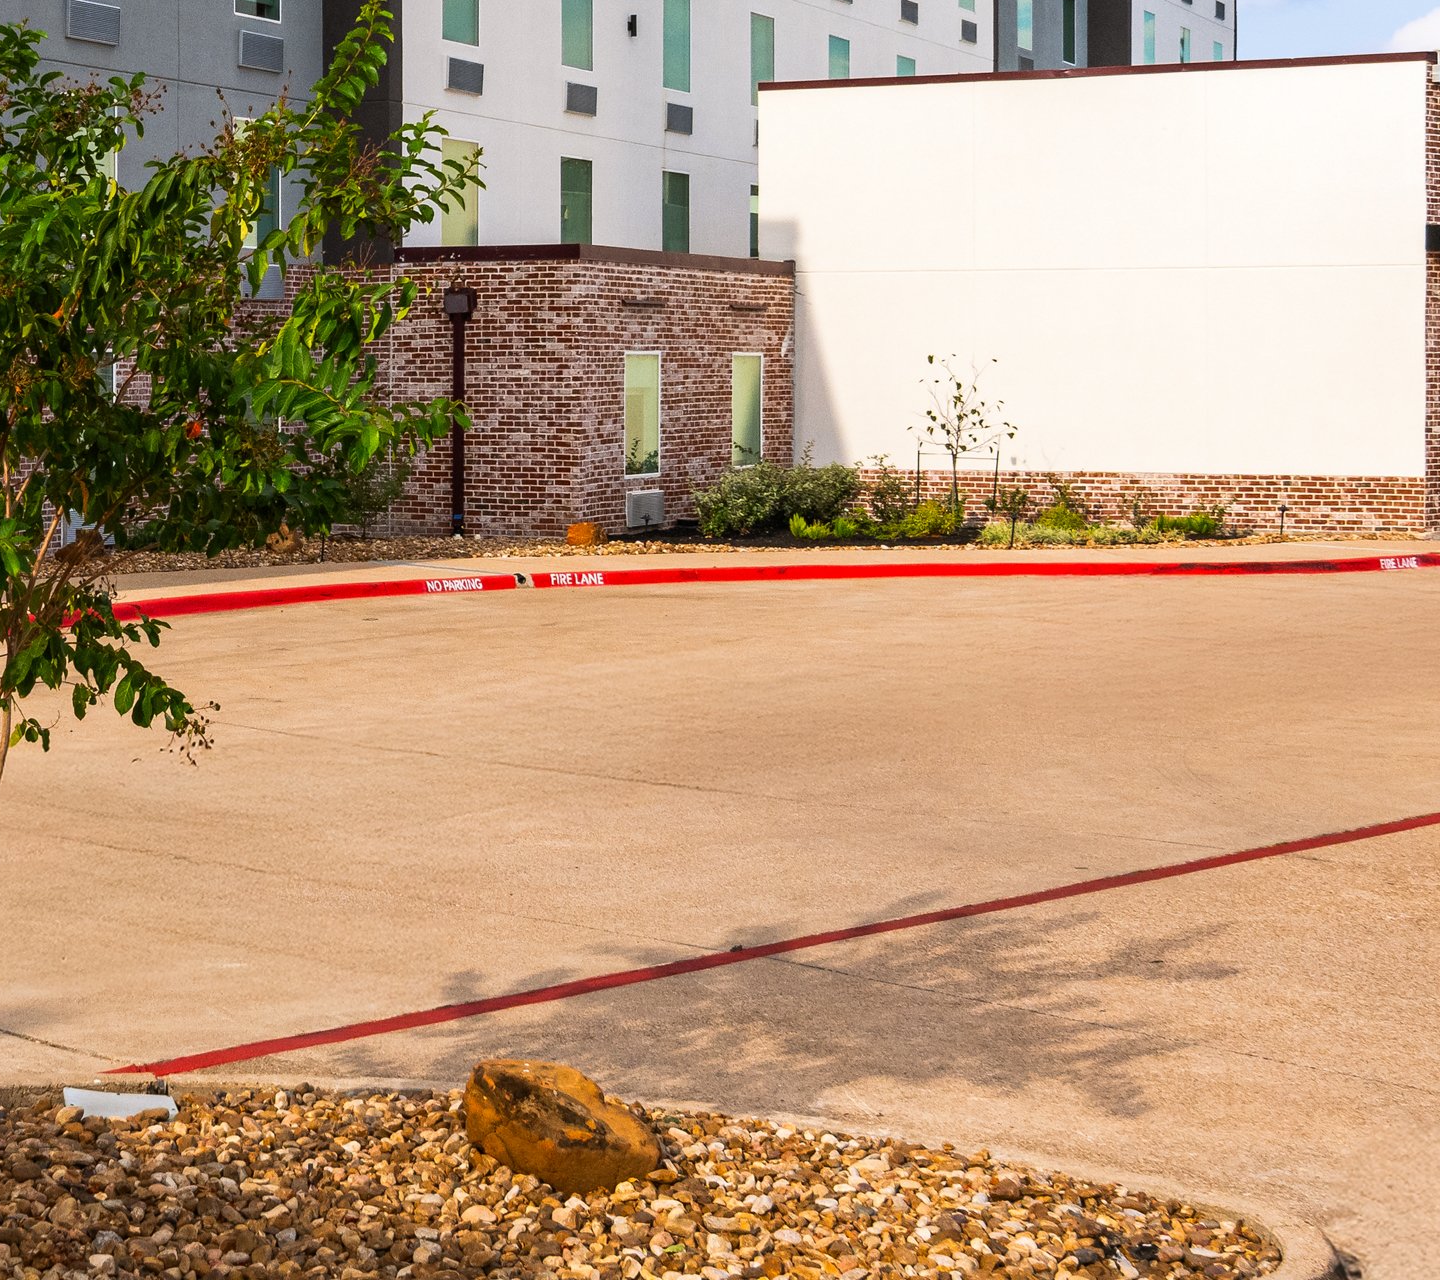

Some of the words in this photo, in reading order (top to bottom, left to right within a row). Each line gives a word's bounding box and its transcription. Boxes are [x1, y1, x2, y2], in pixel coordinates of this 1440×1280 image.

[1379, 558, 1397, 569] FIRE
[1397, 557, 1419, 569] LANE
[425, 580, 442, 593] NO
[442, 578, 483, 592] PARKING
[550, 573, 573, 586] FIRE
[574, 572, 605, 585] LANE
